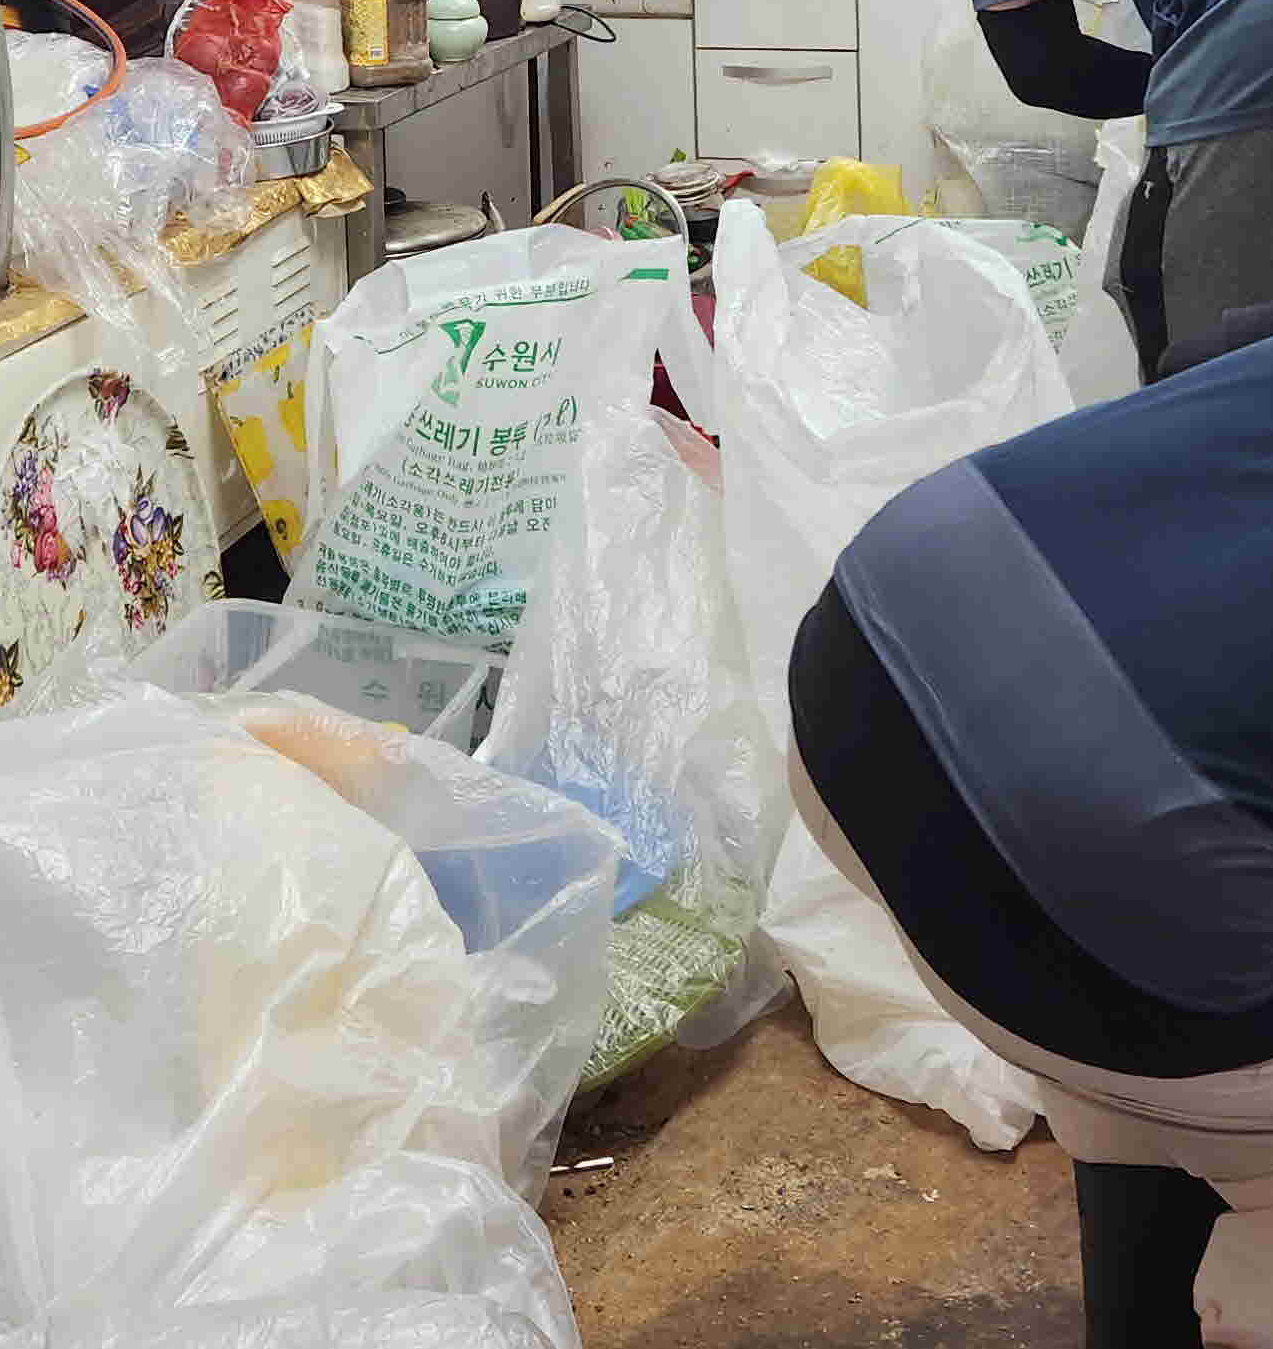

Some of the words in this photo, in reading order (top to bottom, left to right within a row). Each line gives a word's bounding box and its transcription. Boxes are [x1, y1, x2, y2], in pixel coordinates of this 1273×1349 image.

[481, 336, 562, 373] 수원시
[475, 378, 527, 390] SUWON
[489, 421, 528, 458] 봉투
